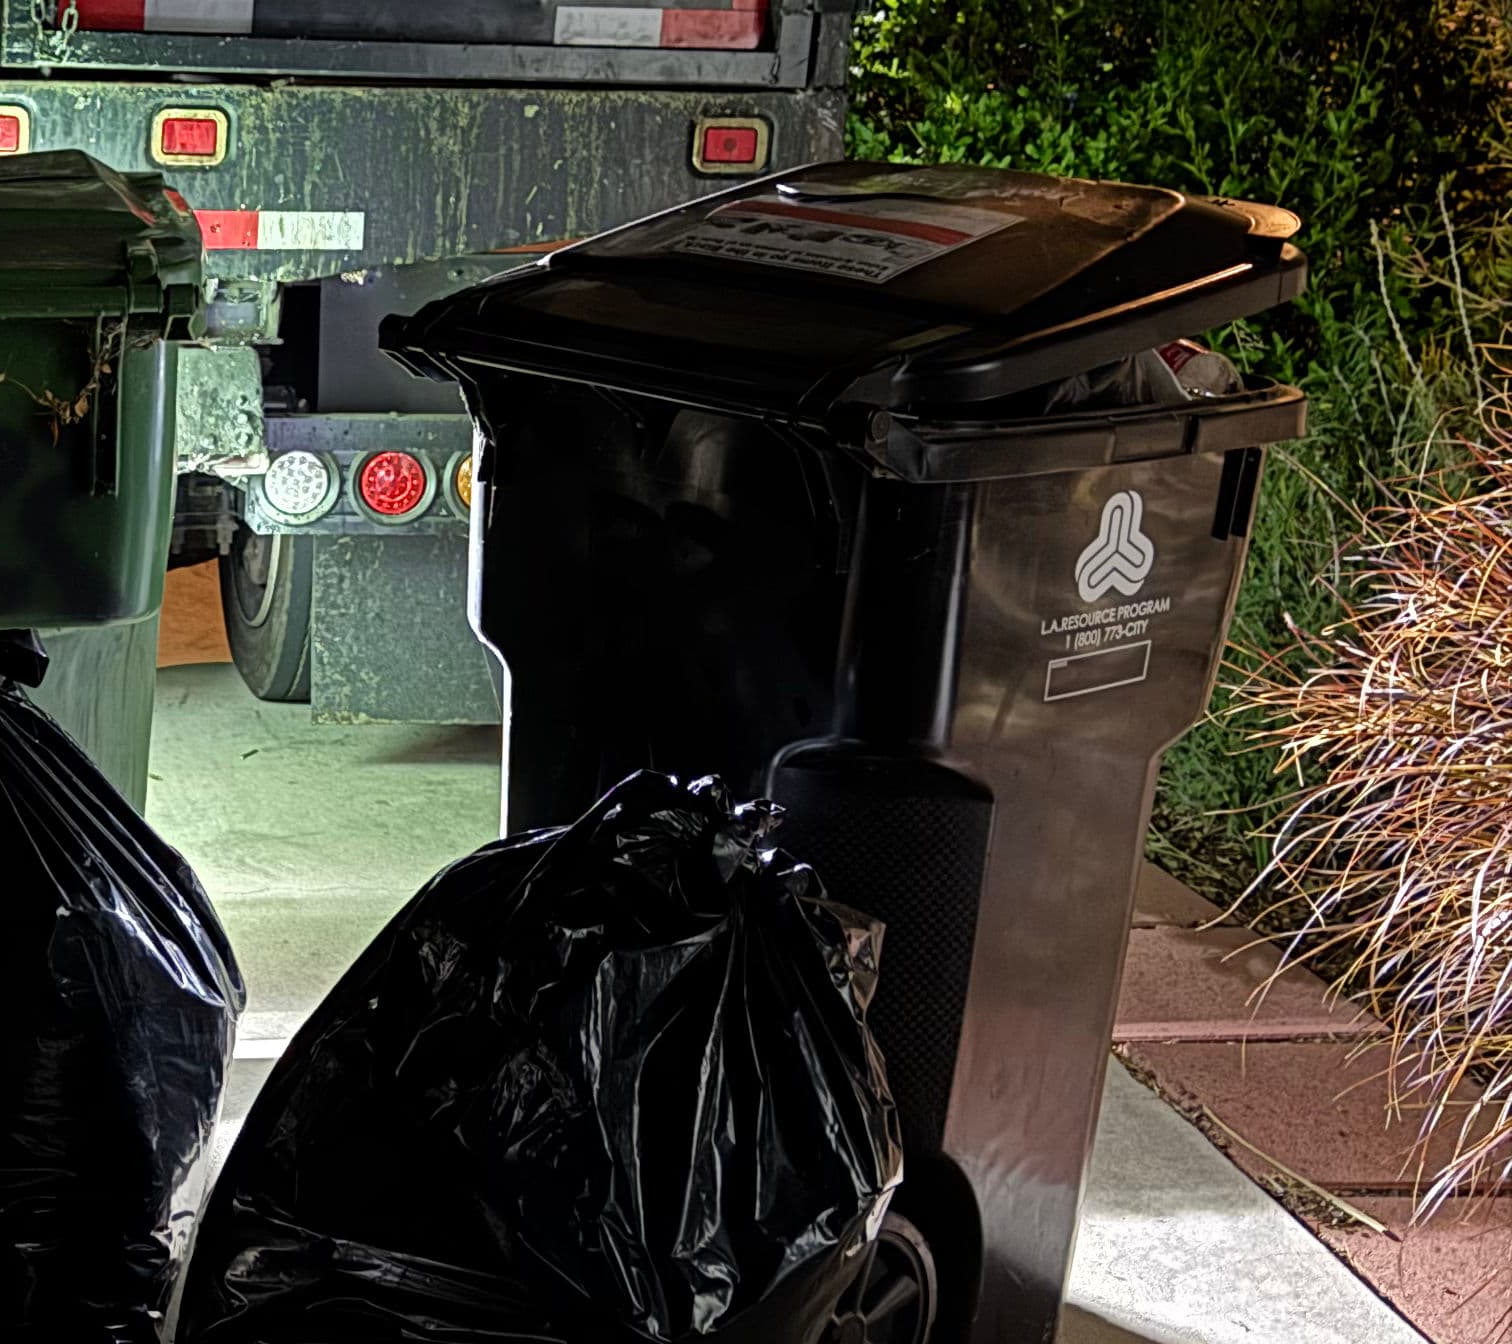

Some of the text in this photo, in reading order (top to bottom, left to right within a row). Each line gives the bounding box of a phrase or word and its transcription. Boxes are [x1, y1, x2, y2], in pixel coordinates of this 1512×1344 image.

[1117, 597, 1170, 620] PROGRAM
[1065, 620, 1149, 651] 1 (800) 773-CITY
